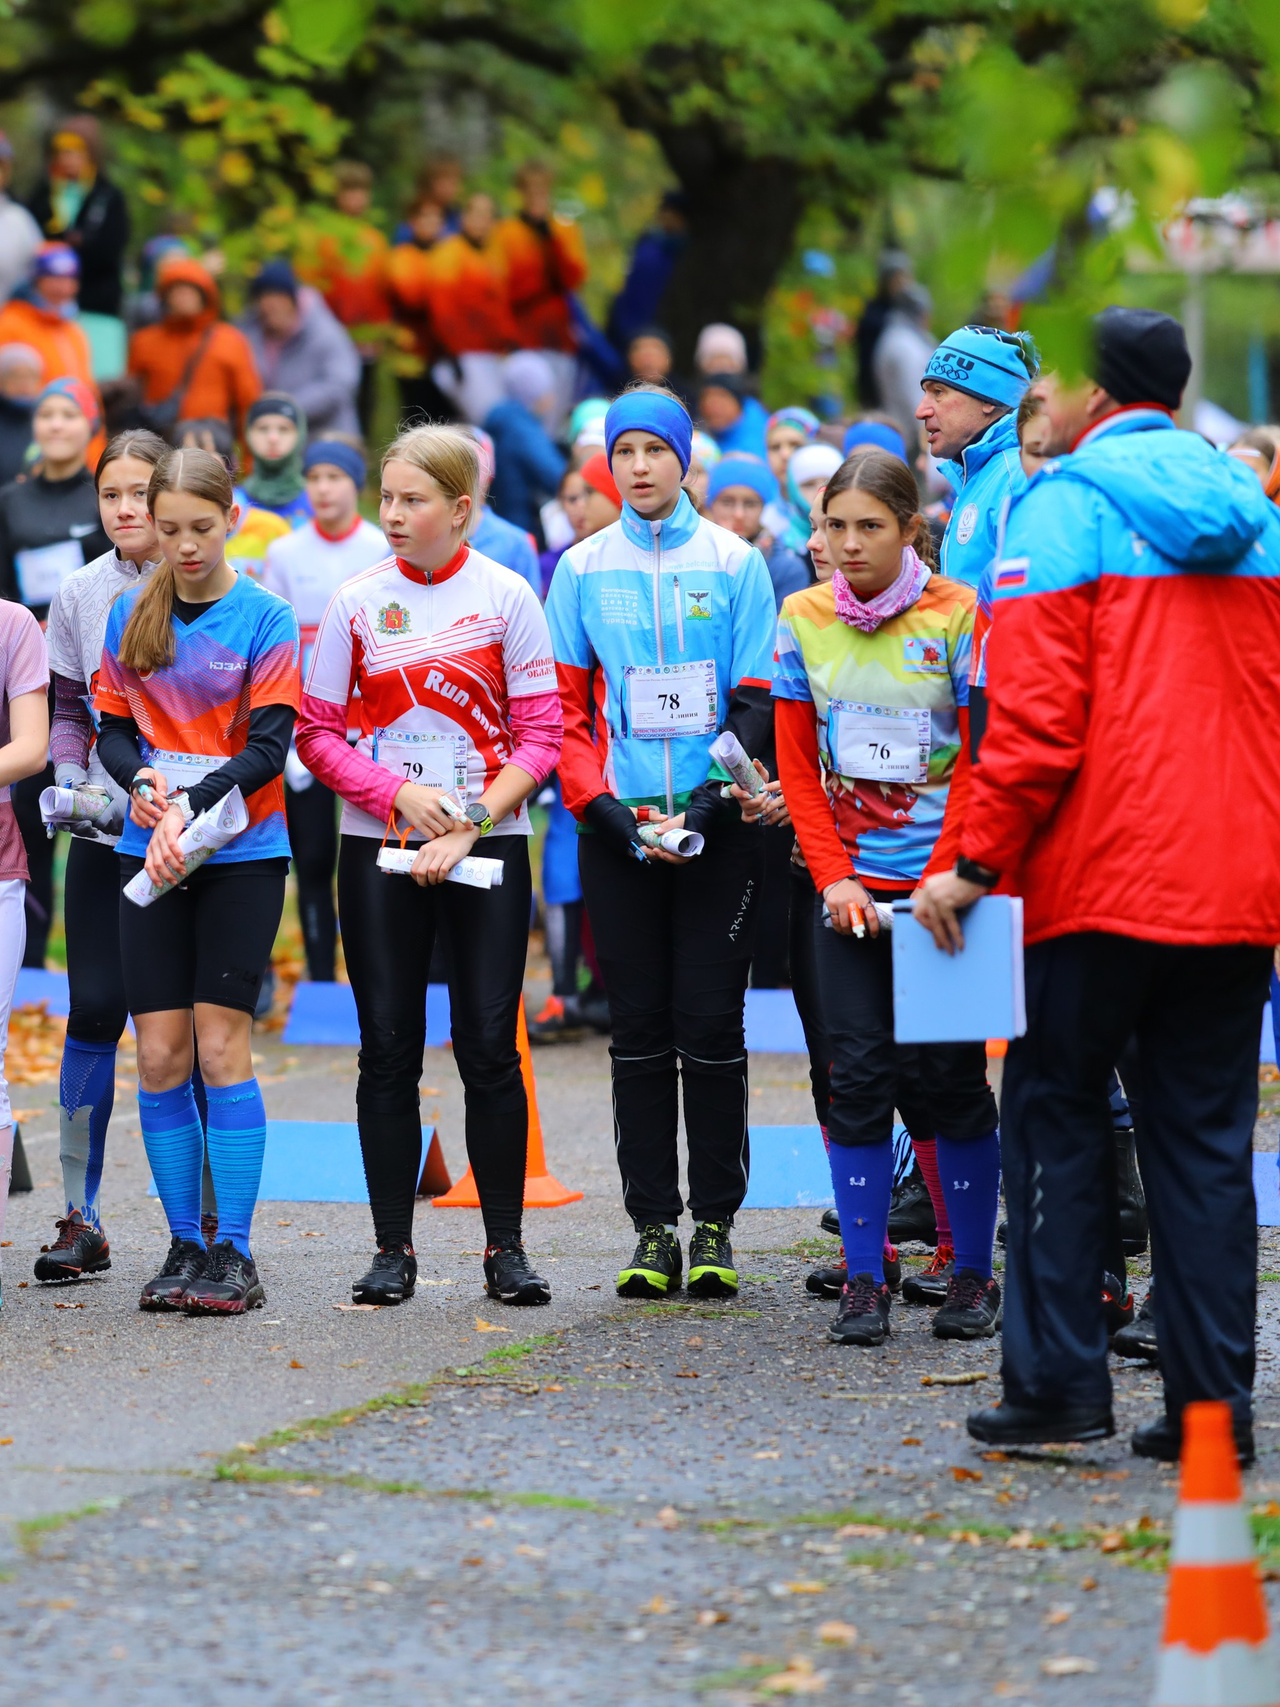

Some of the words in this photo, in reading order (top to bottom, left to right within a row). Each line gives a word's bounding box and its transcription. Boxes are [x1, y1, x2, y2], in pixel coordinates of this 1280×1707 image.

[931, 351, 975, 371] .ru
[423, 668, 470, 707] Run
[471, 704, 500, 739] and
[657, 693, 680, 710] 78
[869, 743, 891, 760] 76
[403, 762, 423, 779] 79
